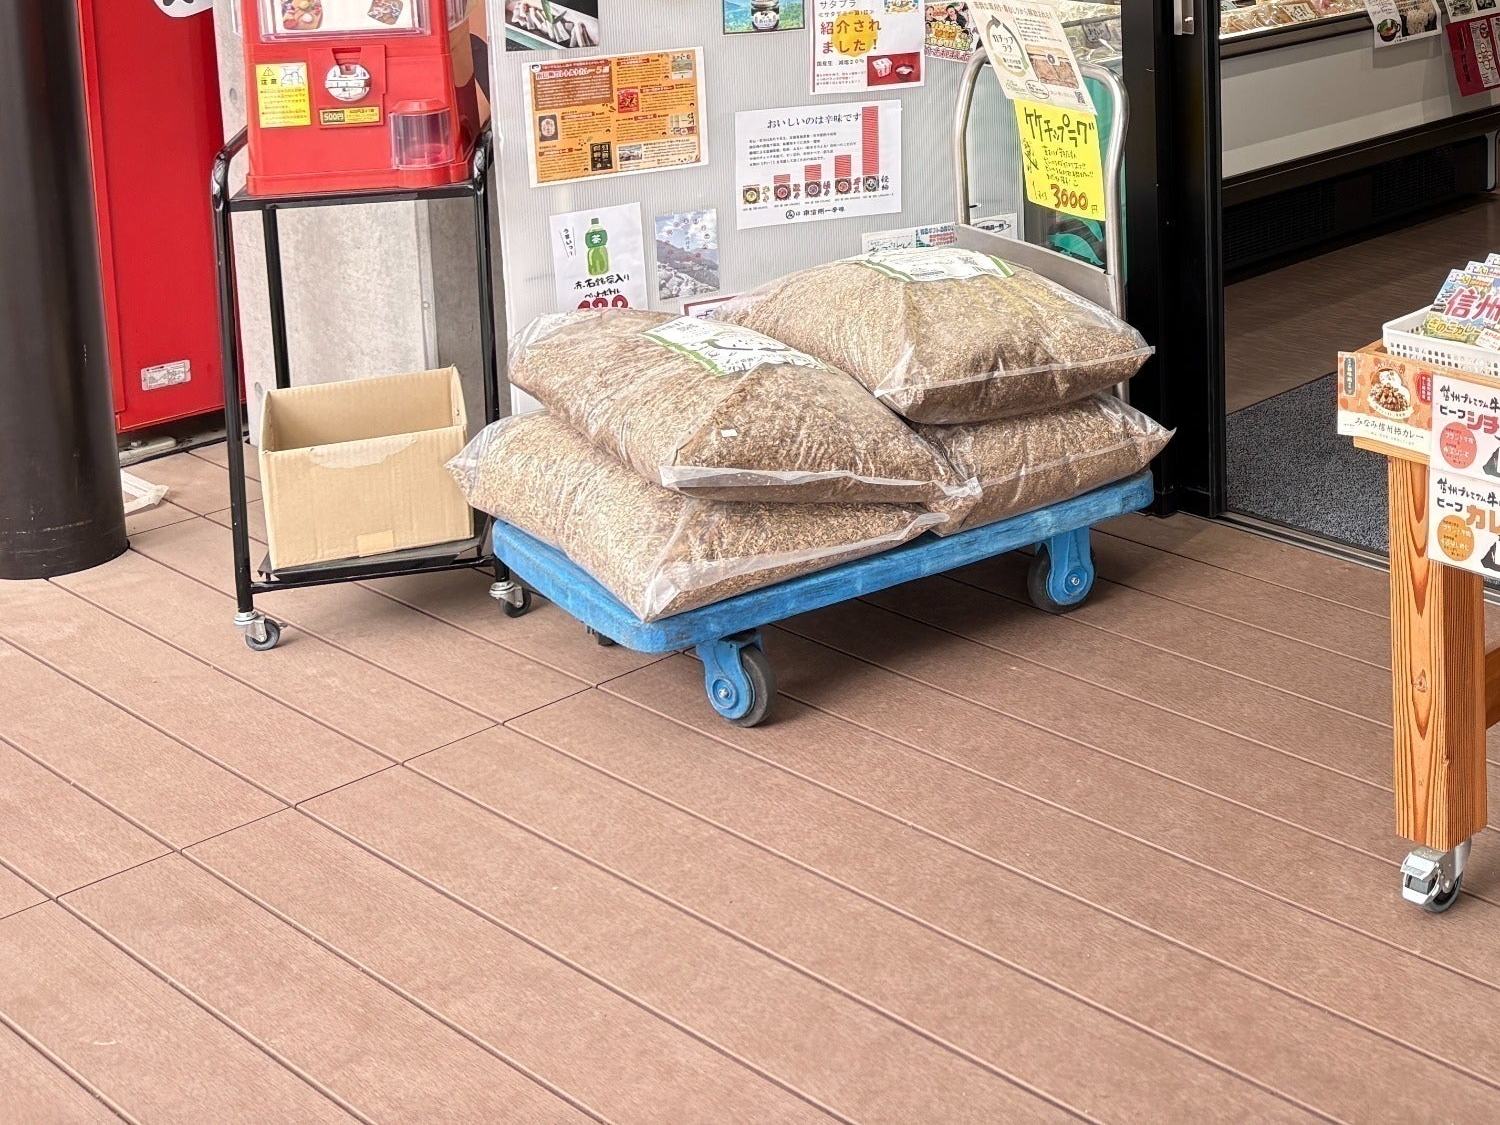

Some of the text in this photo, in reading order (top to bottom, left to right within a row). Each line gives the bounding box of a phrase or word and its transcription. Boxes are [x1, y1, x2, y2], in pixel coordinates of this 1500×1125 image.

[820, 19, 882, 35] 紹介され
[822, 39, 877, 54] ました!
[323, 111, 345, 122] 500円
[592, 234, 601, 244] 茶
[1428, 318, 1482, 335] きのこカレー
